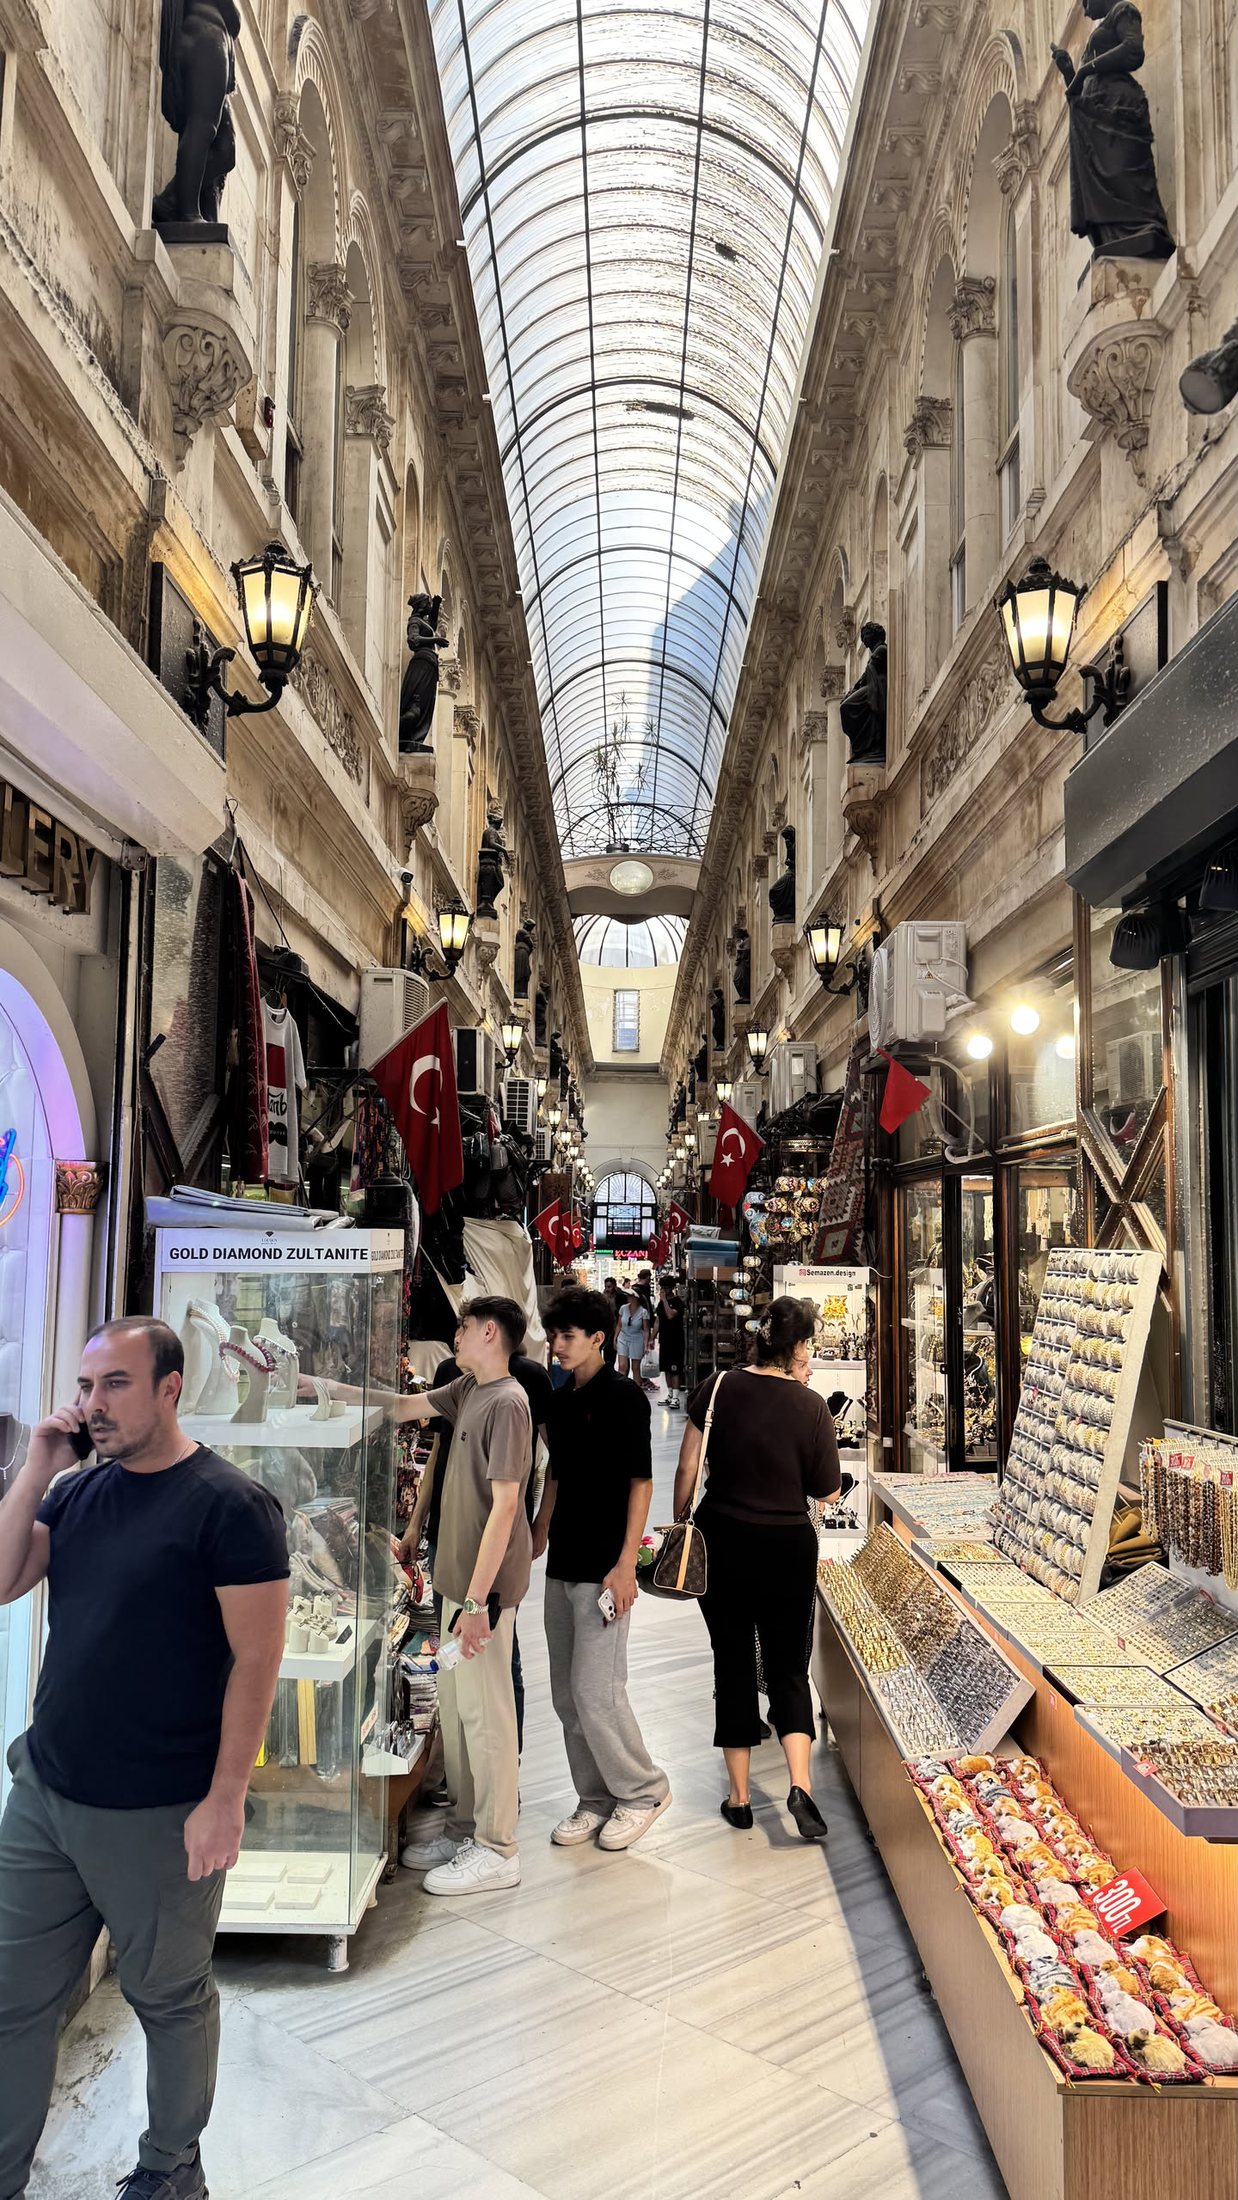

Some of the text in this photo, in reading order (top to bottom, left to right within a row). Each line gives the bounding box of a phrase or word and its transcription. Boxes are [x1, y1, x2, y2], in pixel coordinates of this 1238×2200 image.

[169, 1247, 369, 1260] GOLD DIAMOND ZULTANITE
[806, 1269, 856, 1278] Semazen.design
